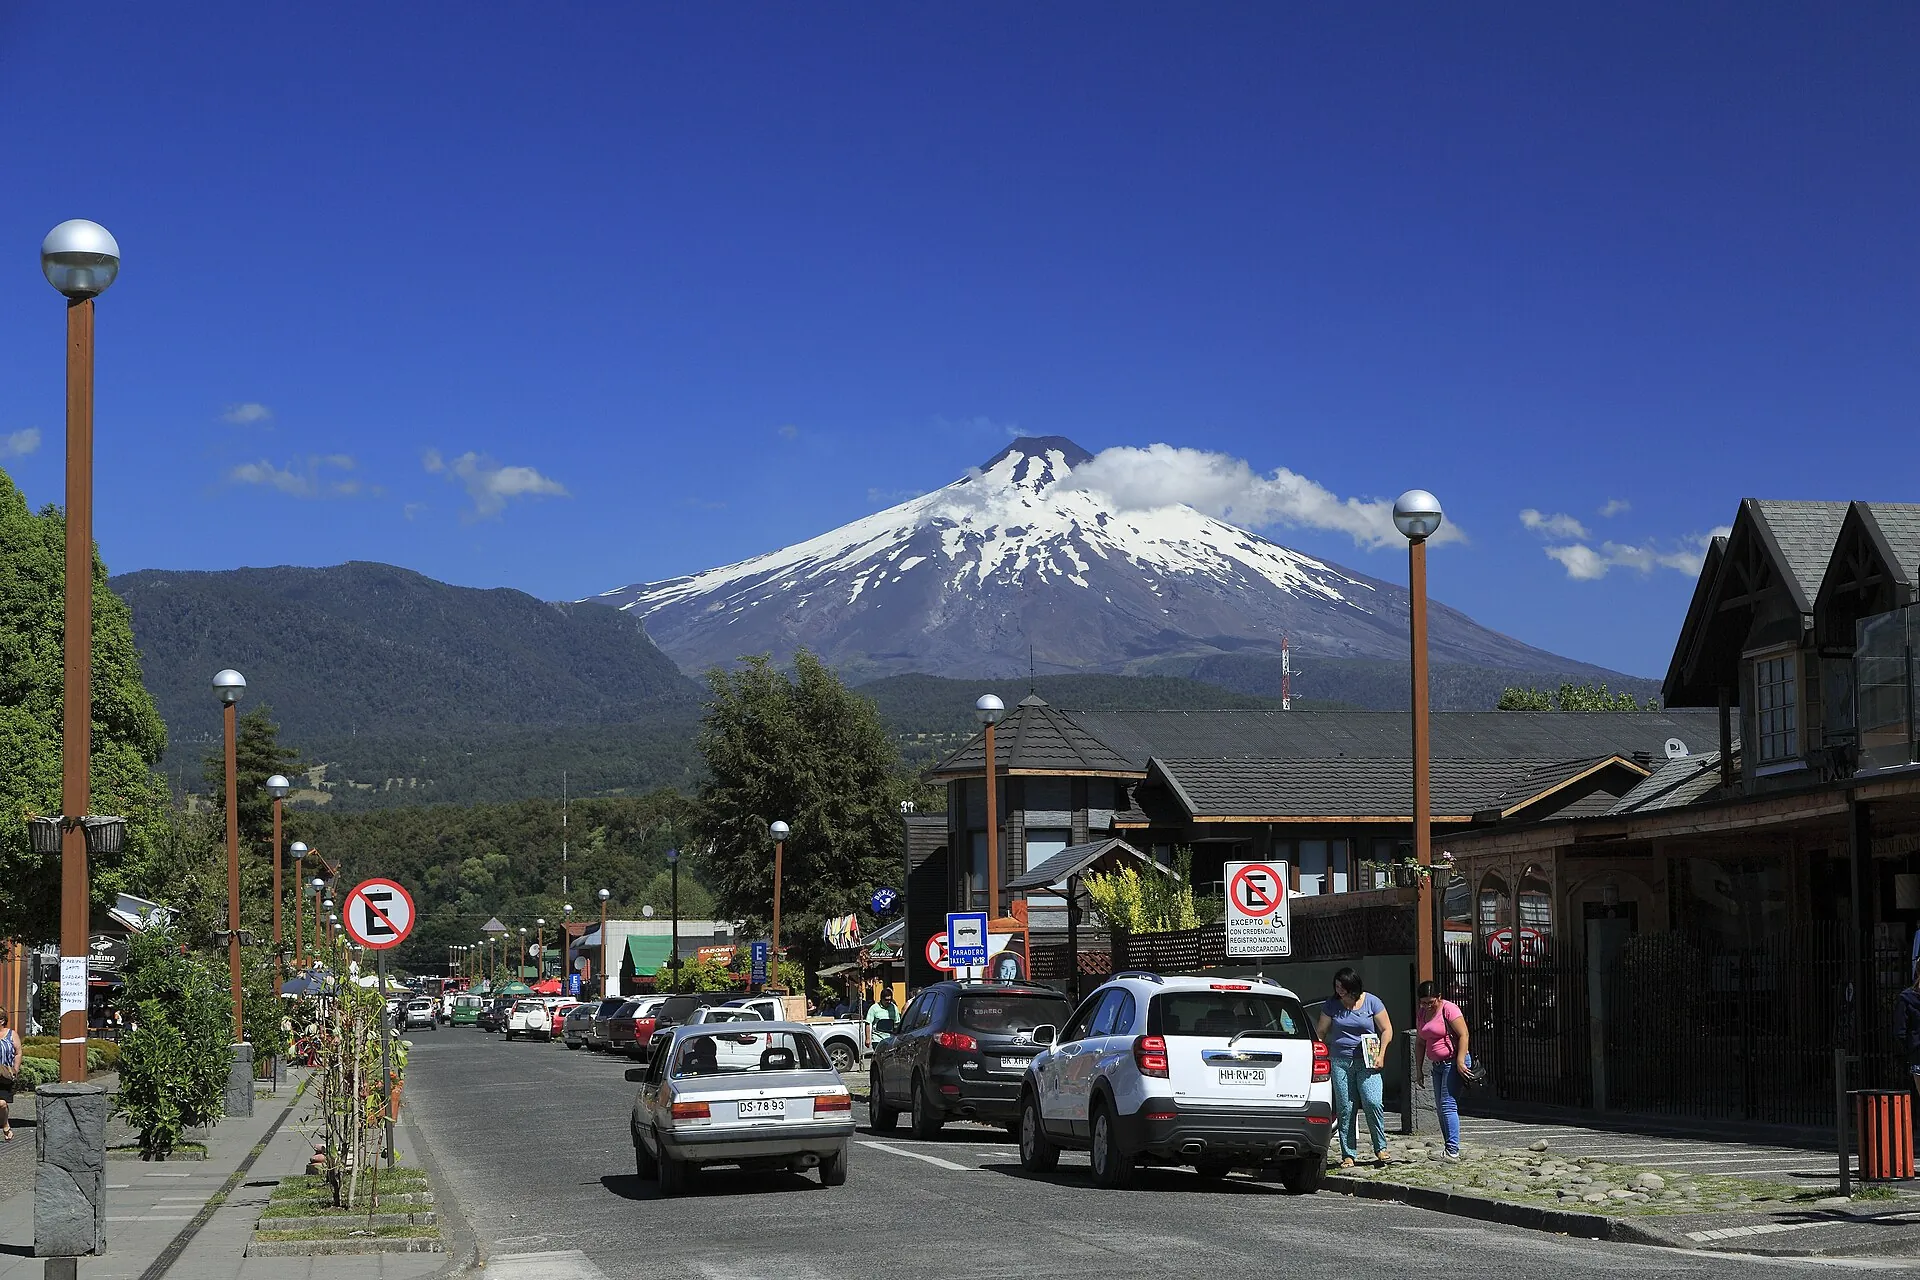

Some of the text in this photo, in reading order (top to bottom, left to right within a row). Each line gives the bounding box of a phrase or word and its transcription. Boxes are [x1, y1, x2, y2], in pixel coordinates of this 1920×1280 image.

[1246, 875, 1269, 906] E
[364, 892, 396, 935] E
[1230, 918, 1263, 926] EXCEPTO
[756, 945, 763, 961] E
[952, 948, 985, 956] PARADERO
[1246, 945, 1287, 953] DISCAPACIDAD
[949, 957, 966, 965] TAXIS
